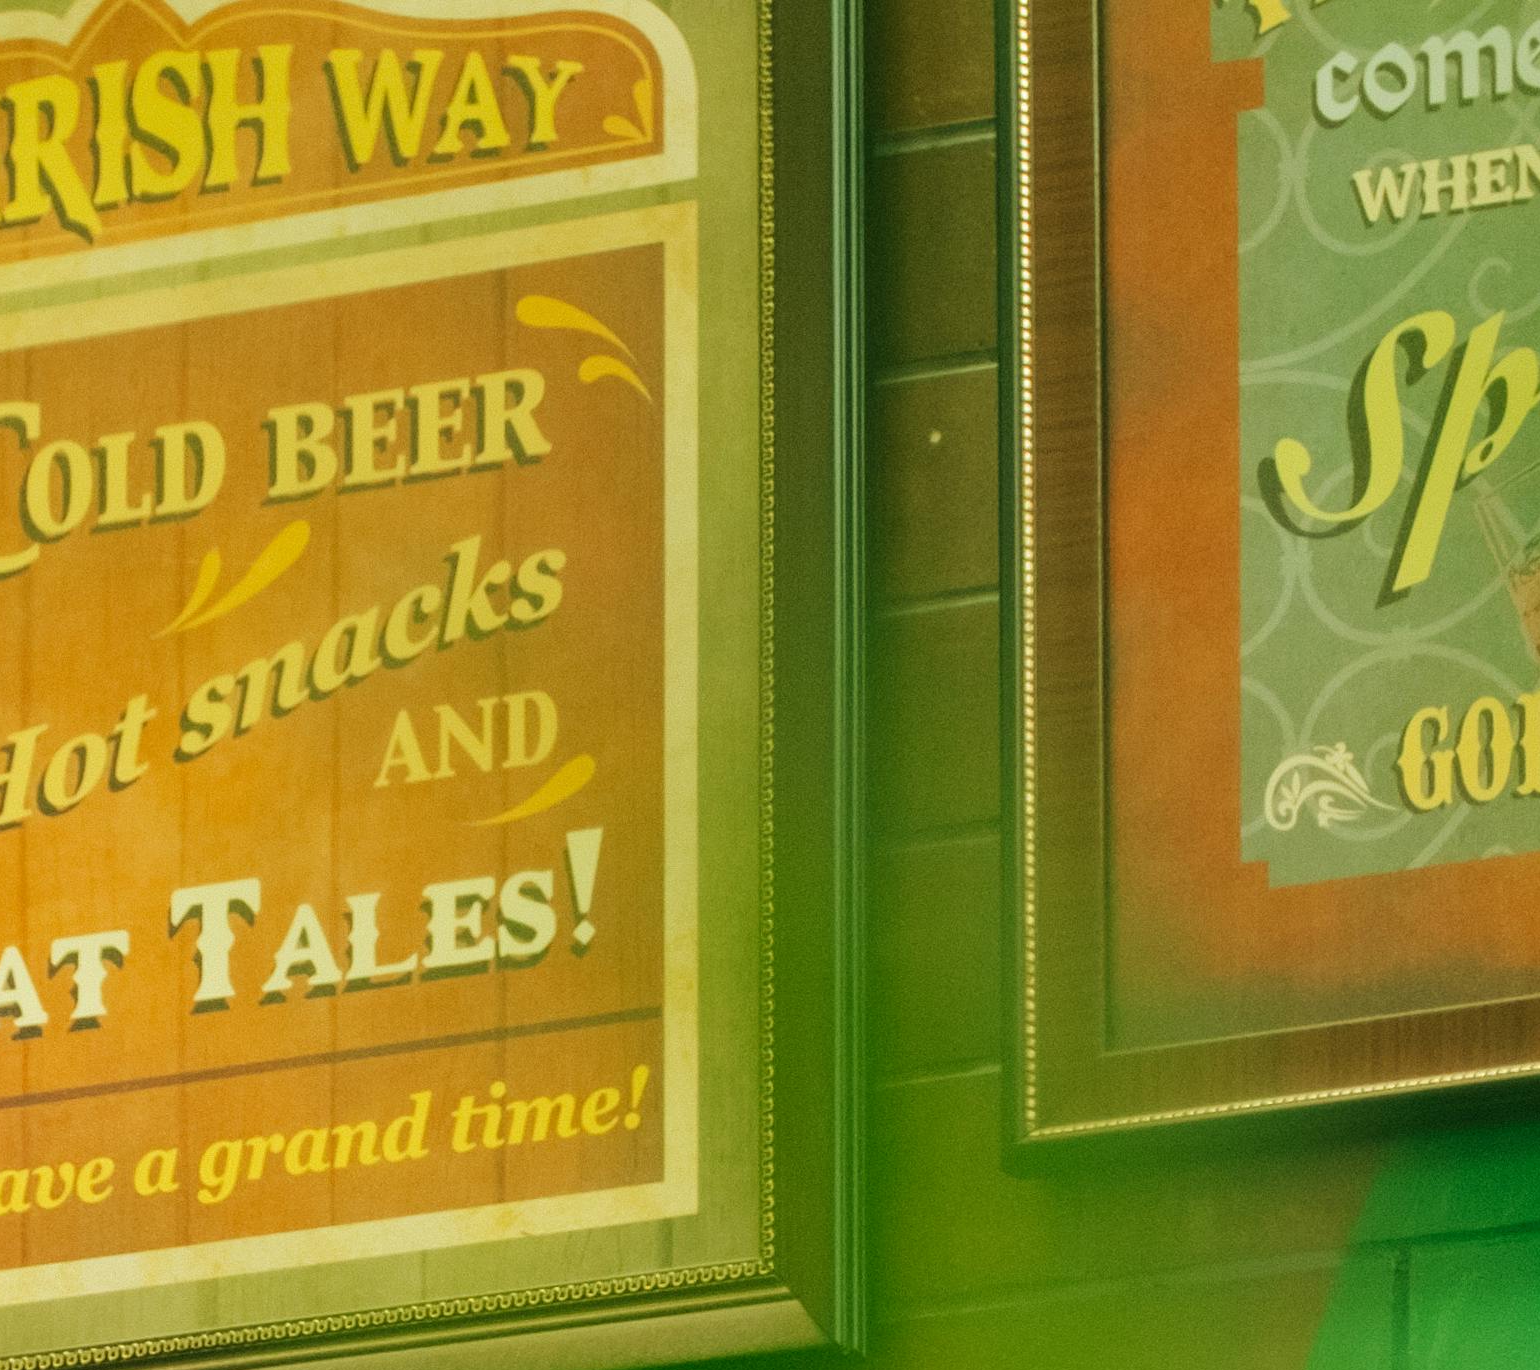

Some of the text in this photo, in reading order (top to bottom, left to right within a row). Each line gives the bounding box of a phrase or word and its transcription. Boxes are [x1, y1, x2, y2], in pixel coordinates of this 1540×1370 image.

[330, 49, 584, 166] WAY
[270, 366, 553, 501] BEER
[177, 534, 565, 763] snacks
[374, 689, 560, 788] AND
[168, 828, 606, 1012] TALES!
[133, 1143, 179, 1194] a
[199, 1092, 430, 1203] grand
[449, 1066, 653, 1143] time!
